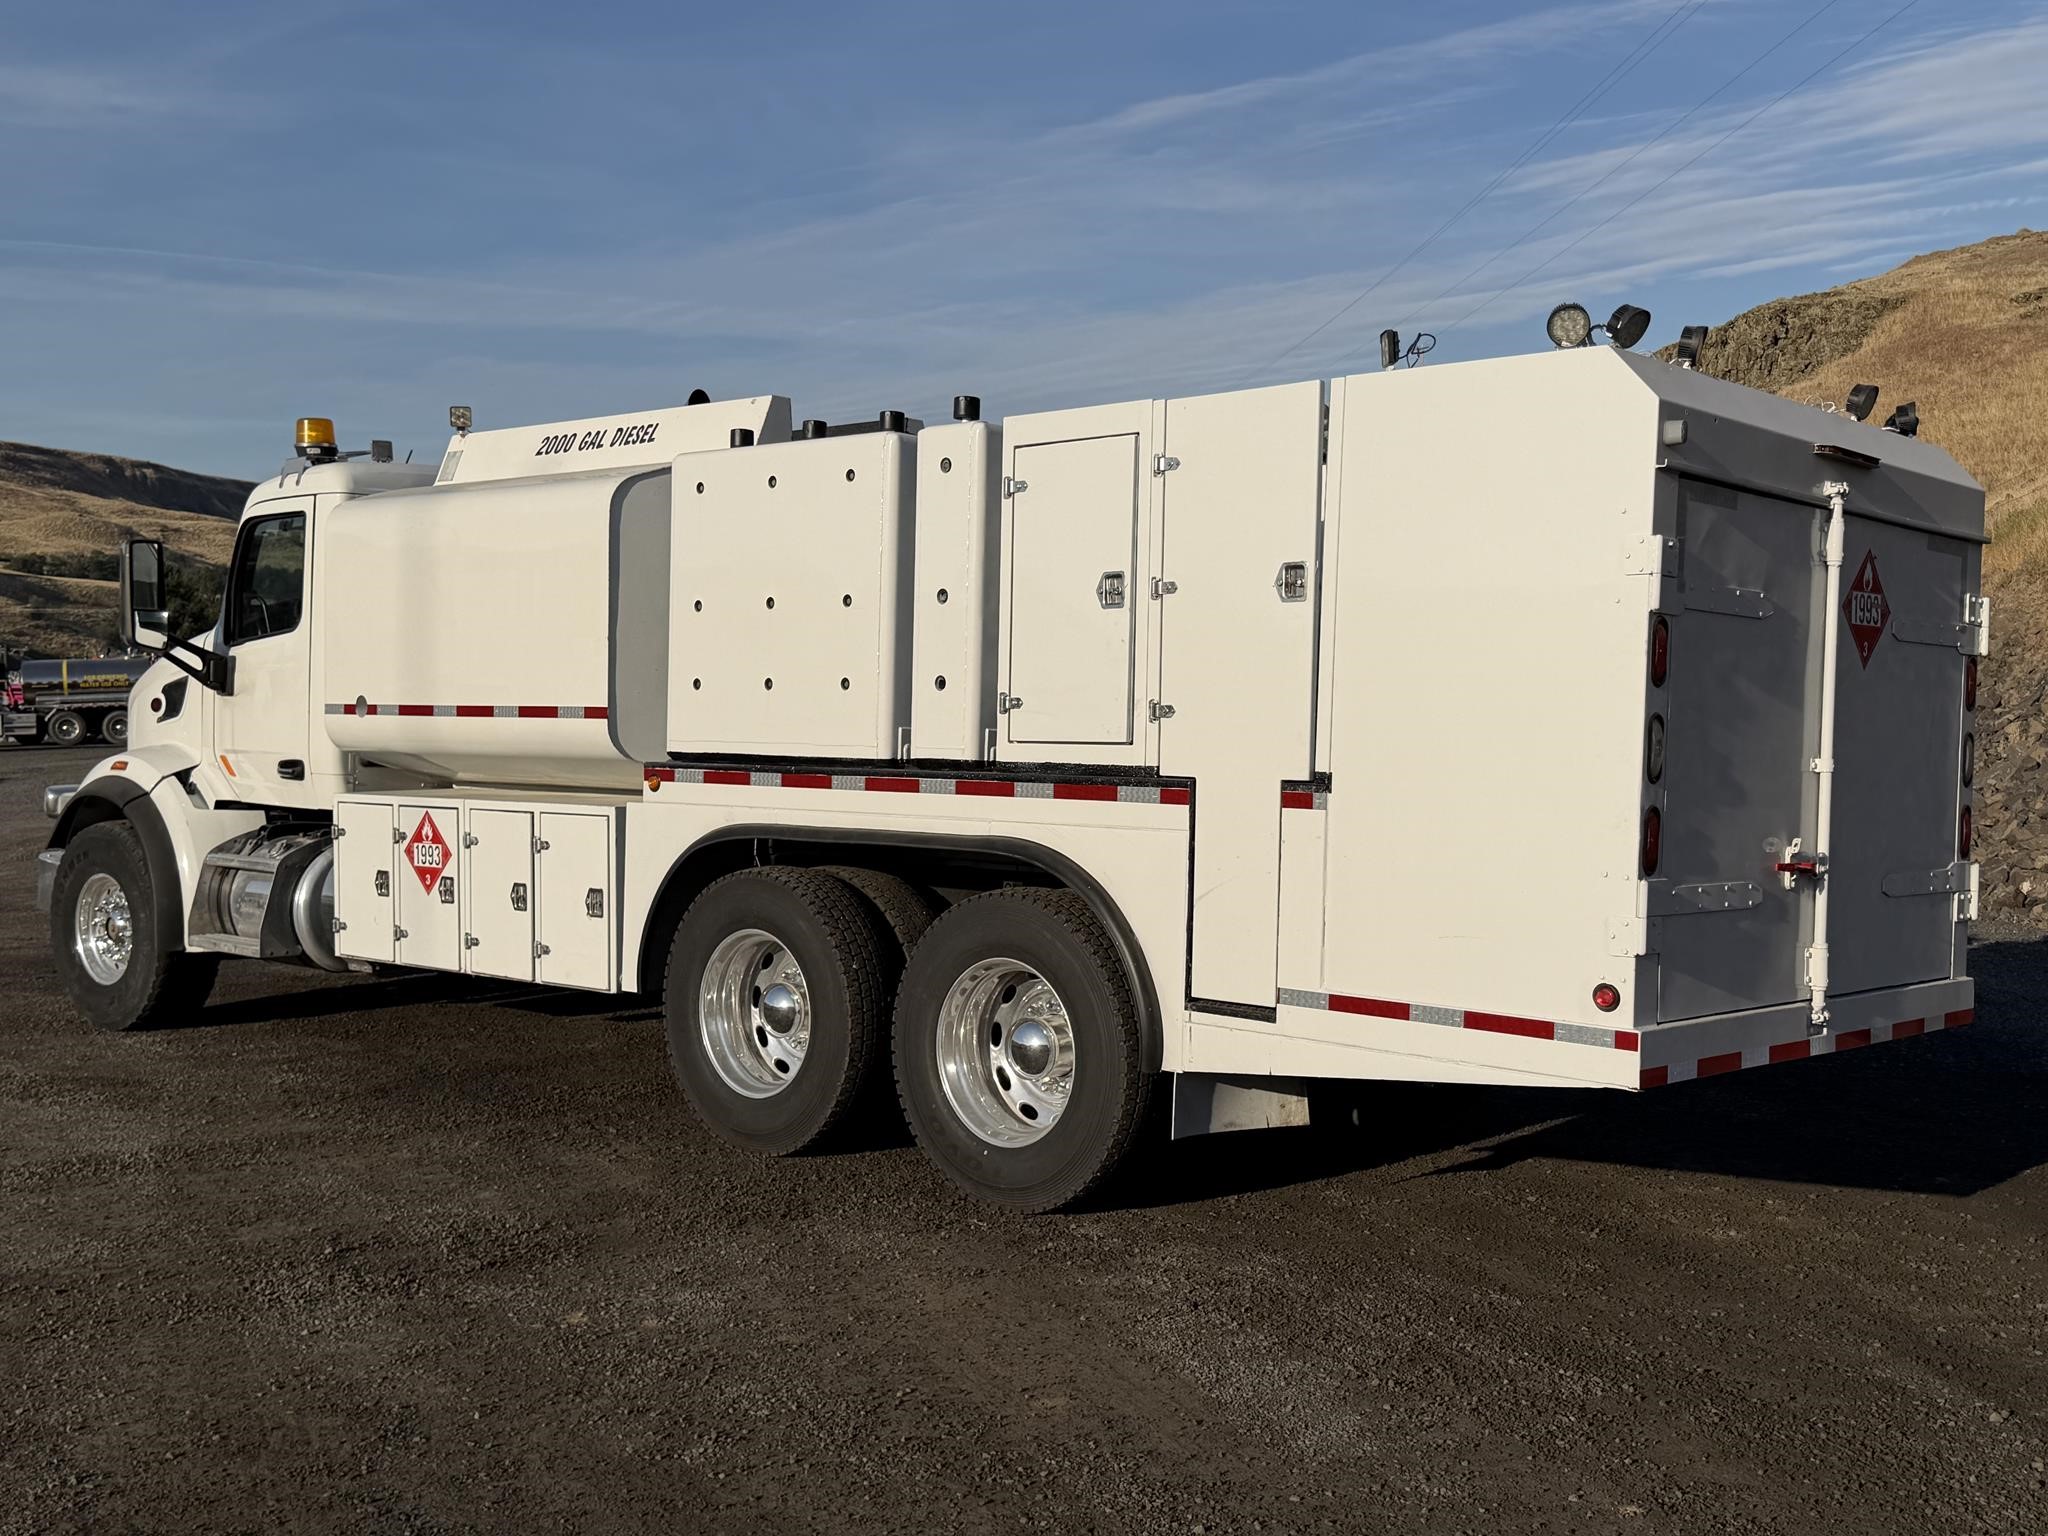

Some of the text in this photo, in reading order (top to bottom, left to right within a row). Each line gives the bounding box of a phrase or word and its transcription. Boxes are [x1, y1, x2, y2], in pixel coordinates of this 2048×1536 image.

[535, 423, 659, 456] 2000 GAL DIESEL
[1854, 593, 1880, 626] 1993
[1863, 641, 1868, 656] 3
[415, 844, 441, 866] 1993
[425, 874, 431, 885] 3
